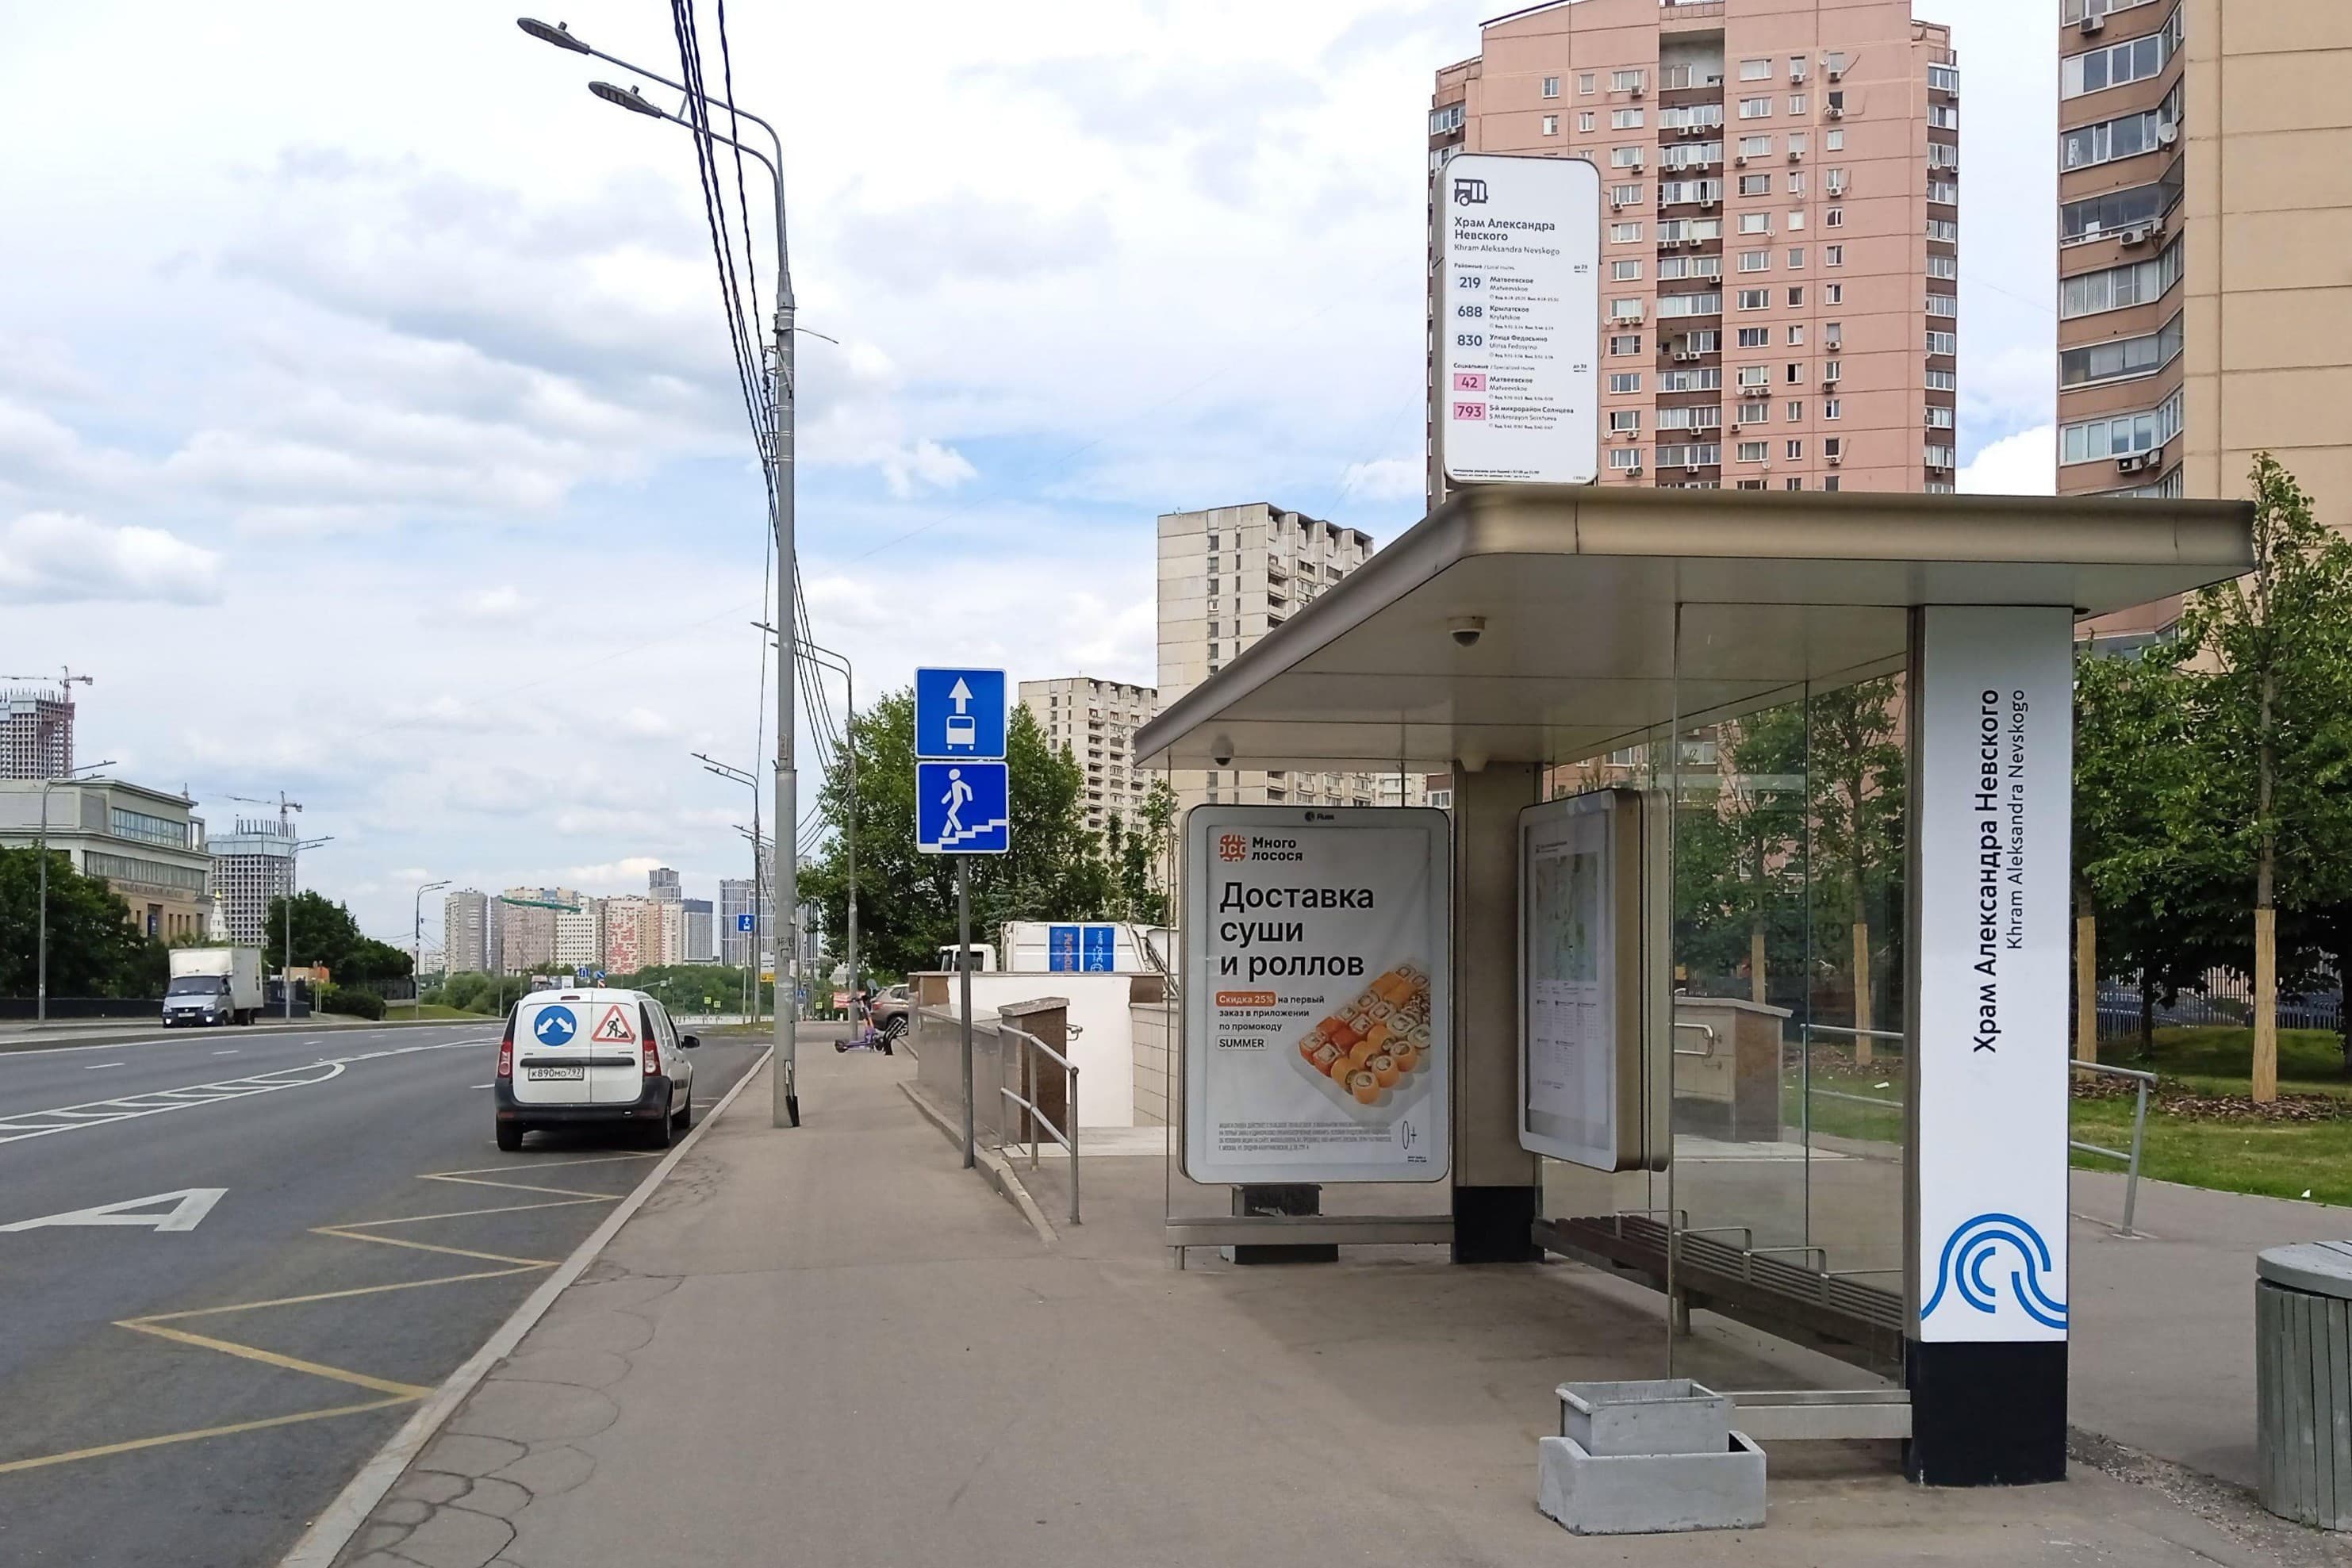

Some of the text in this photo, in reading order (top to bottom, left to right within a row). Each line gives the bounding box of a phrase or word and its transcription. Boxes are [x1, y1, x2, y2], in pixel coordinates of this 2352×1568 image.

[1454, 217, 1555, 232] Храм Александра
[1455, 230, 1508, 241] Невского
[1480, 245, 1522, 254] Aleksandra
[1524, 247, 1560, 255] Nevskogo
[1460, 277, 1481, 289] 219
[1458, 305, 1483, 317] 688
[1457, 335, 1483, 347] 830
[1461, 377, 1478, 389] 42
[1457, 405, 1482, 417] 793
[2006, 689, 2028, 949] Khram Aleksandra Nevskogo
[1253, 838, 1296, 849] Много
[1252, 851, 1303, 862] лосося
[1973, 689, 2003, 1053] Храм Александра Невского
[1219, 882, 1374, 913] Доставка
[1220, 922, 1303, 949] суши
[1220, 955, 1364, 982] и роллов
[1219, 995, 1253, 1006] Скидка
[1254, 995, 1274, 1005] 25%
[1290, 995, 1325, 1005] первый
[1253, 1009, 1310, 1019] приложении
[1232, 1023, 1283, 1033] промокоду
[1219, 1038, 1264, 1048] SUMMER
